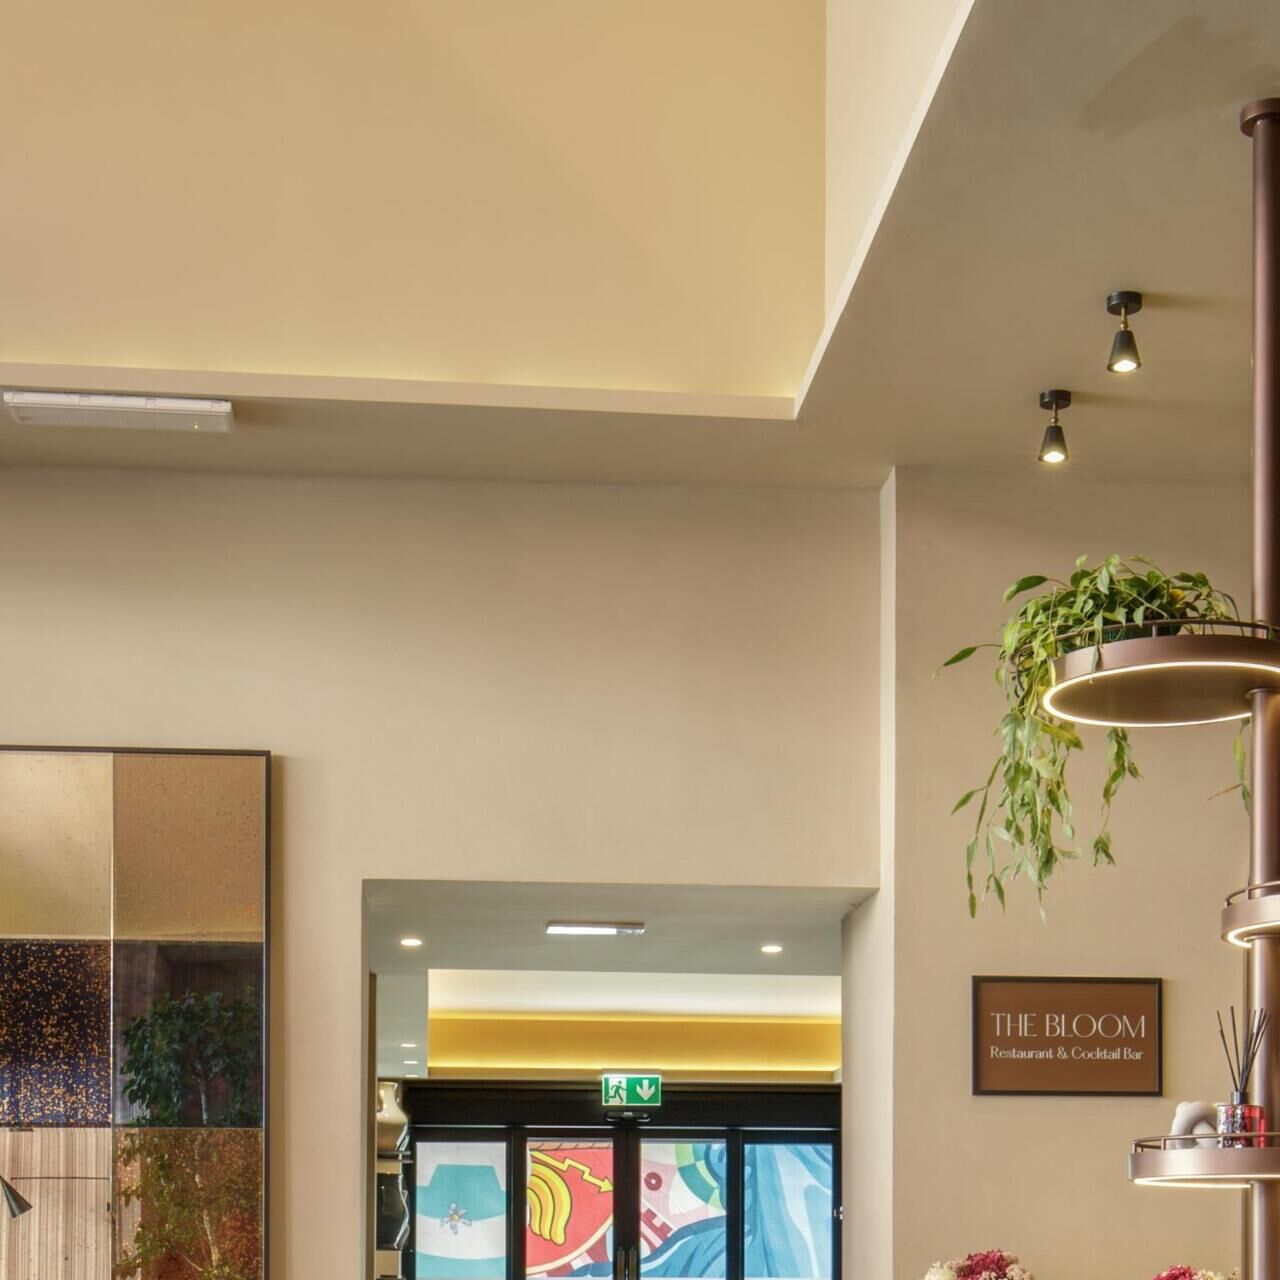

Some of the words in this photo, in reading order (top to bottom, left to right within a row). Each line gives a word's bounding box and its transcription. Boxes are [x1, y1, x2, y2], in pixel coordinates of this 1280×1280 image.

[989, 1012, 1038, 1037] THE
[1045, 1013, 1146, 1039] BLOOM
[990, 1045, 1054, 1060] Restaurant
[1056, 1047, 1068, 1060] &
[1071, 1047, 1121, 1061] Cocktail
[1123, 1047, 1144, 1061] Bar
